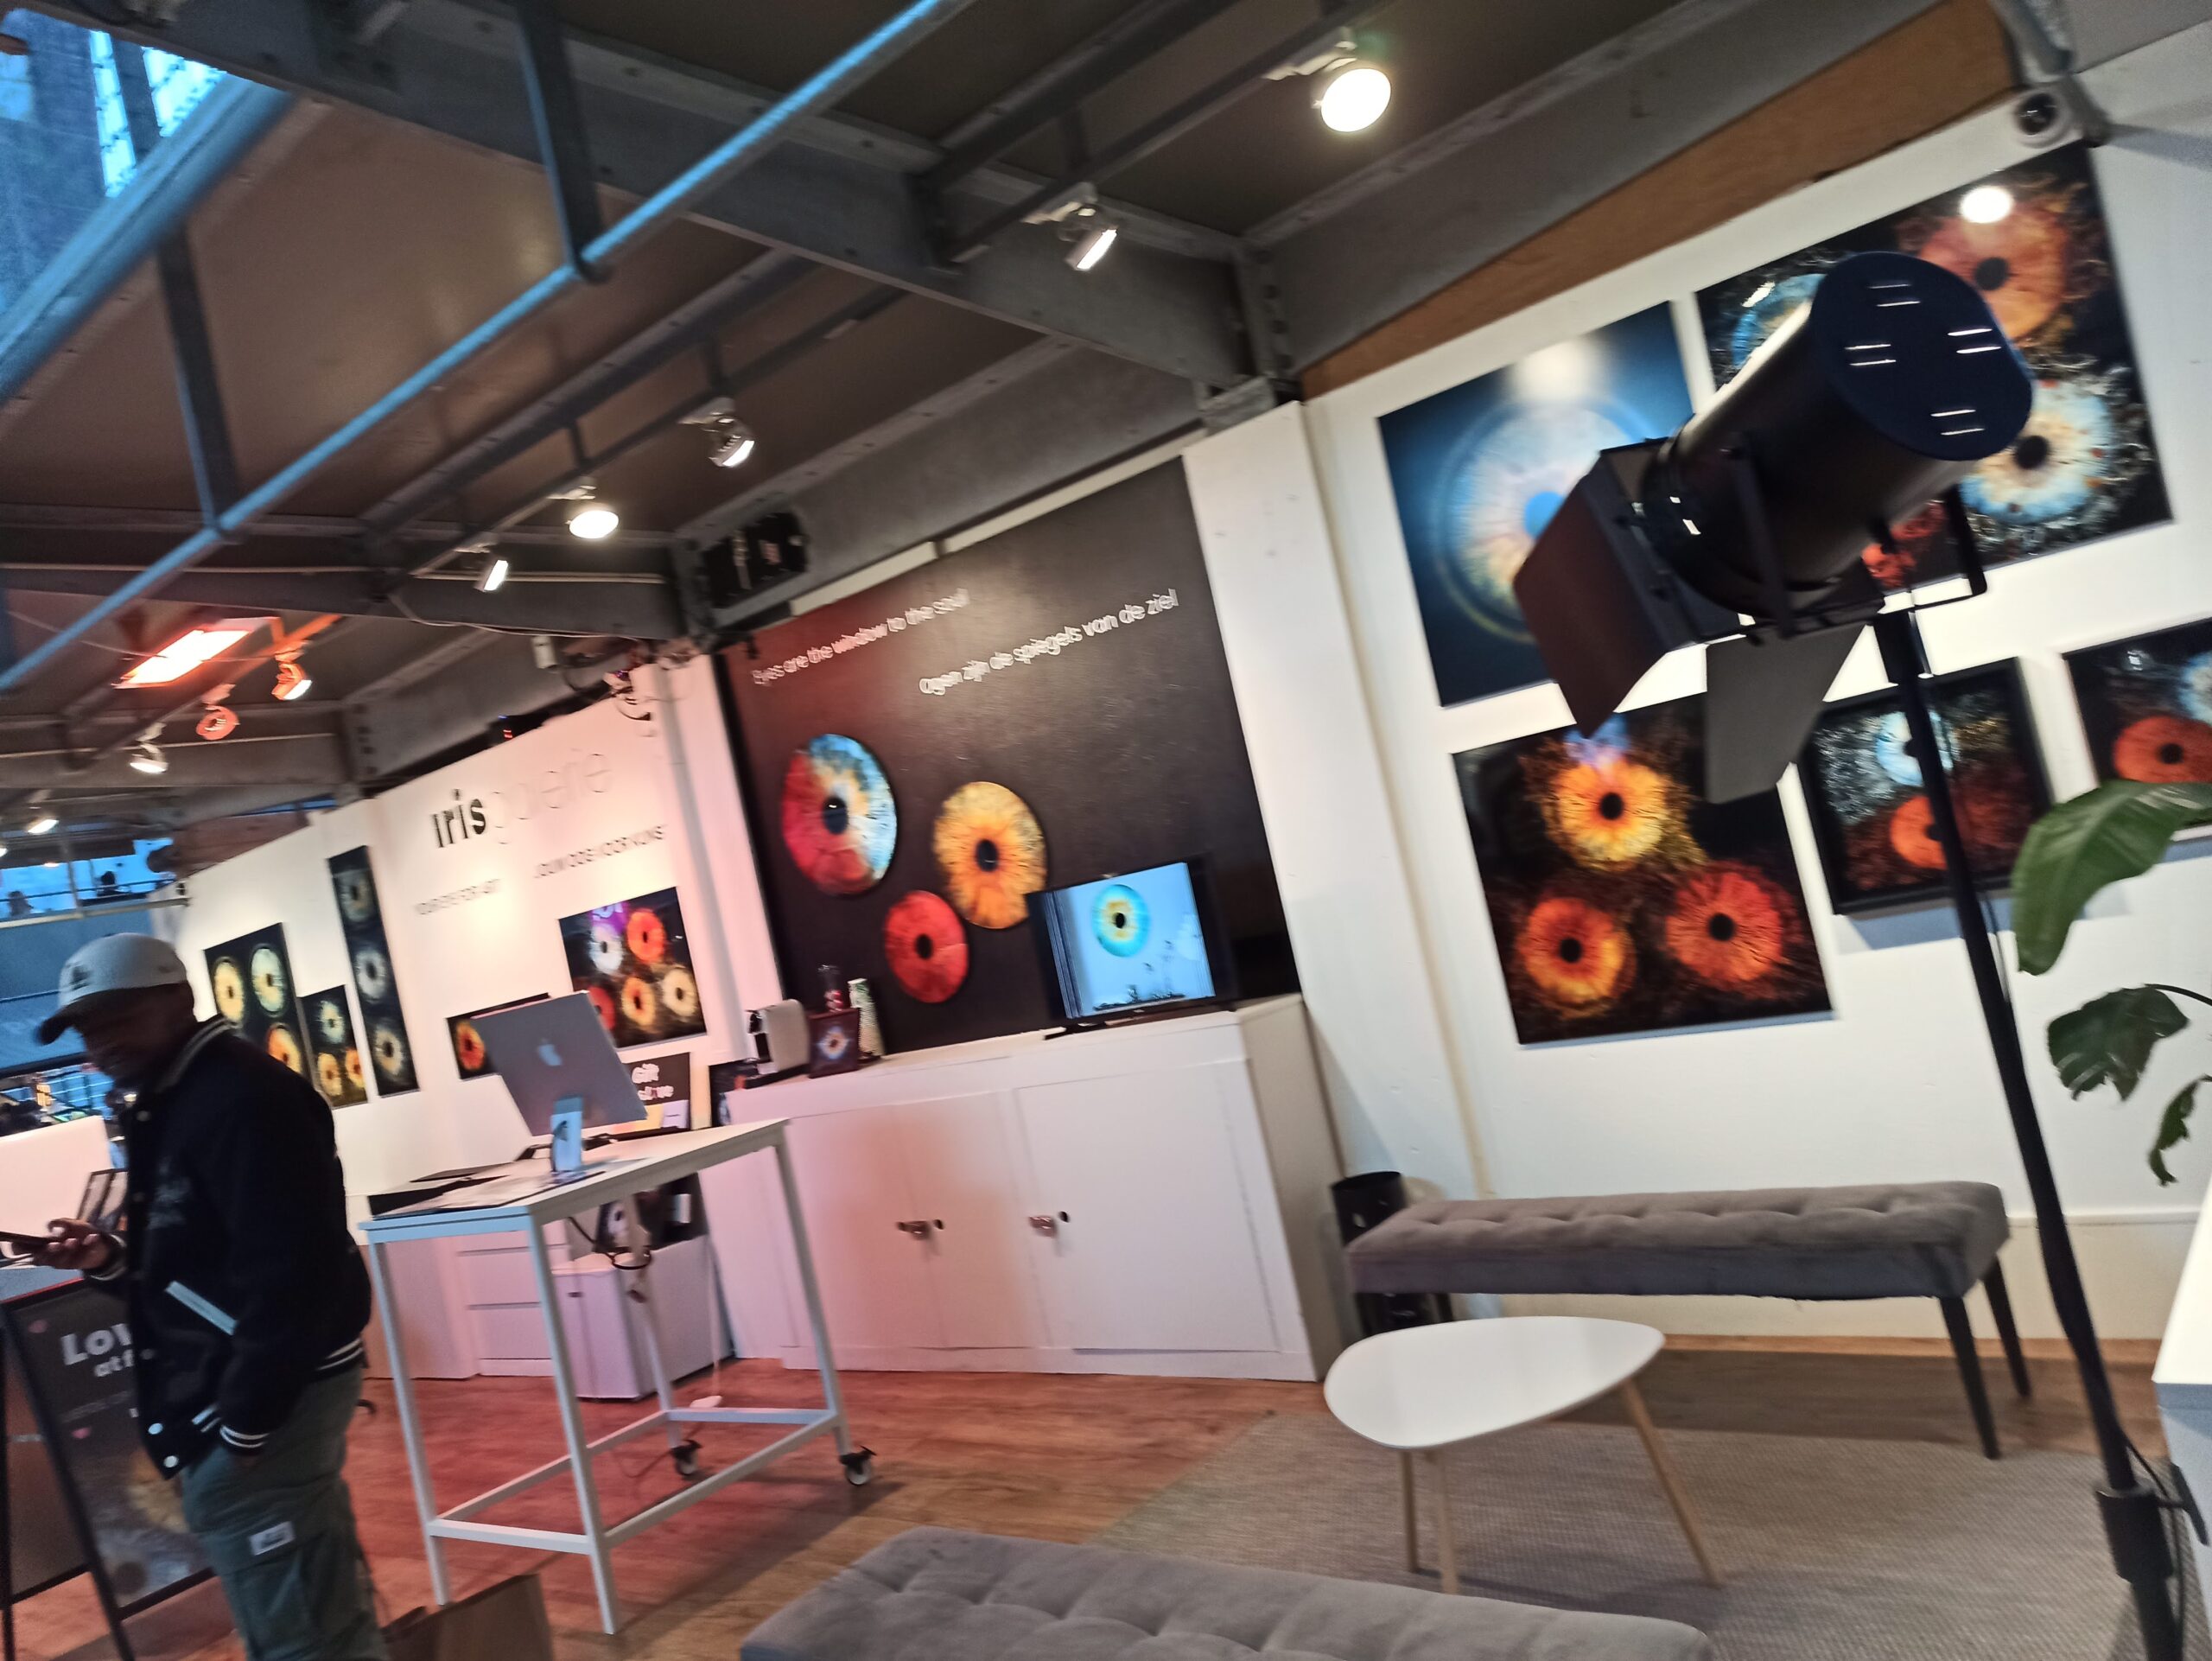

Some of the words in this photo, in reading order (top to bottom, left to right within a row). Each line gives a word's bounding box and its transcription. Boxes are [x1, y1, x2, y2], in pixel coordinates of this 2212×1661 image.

[807, 646, 834, 664] the
[887, 617, 907, 632] to
[906, 607, 936, 626] the
[918, 671, 963, 696] Ogen
[989, 652, 1014, 670] de
[1013, 626, 1084, 665] spiegels
[1081, 614, 1119, 636] van
[1118, 604, 1146, 624] de
[1145, 588, 1179, 615] ziel
